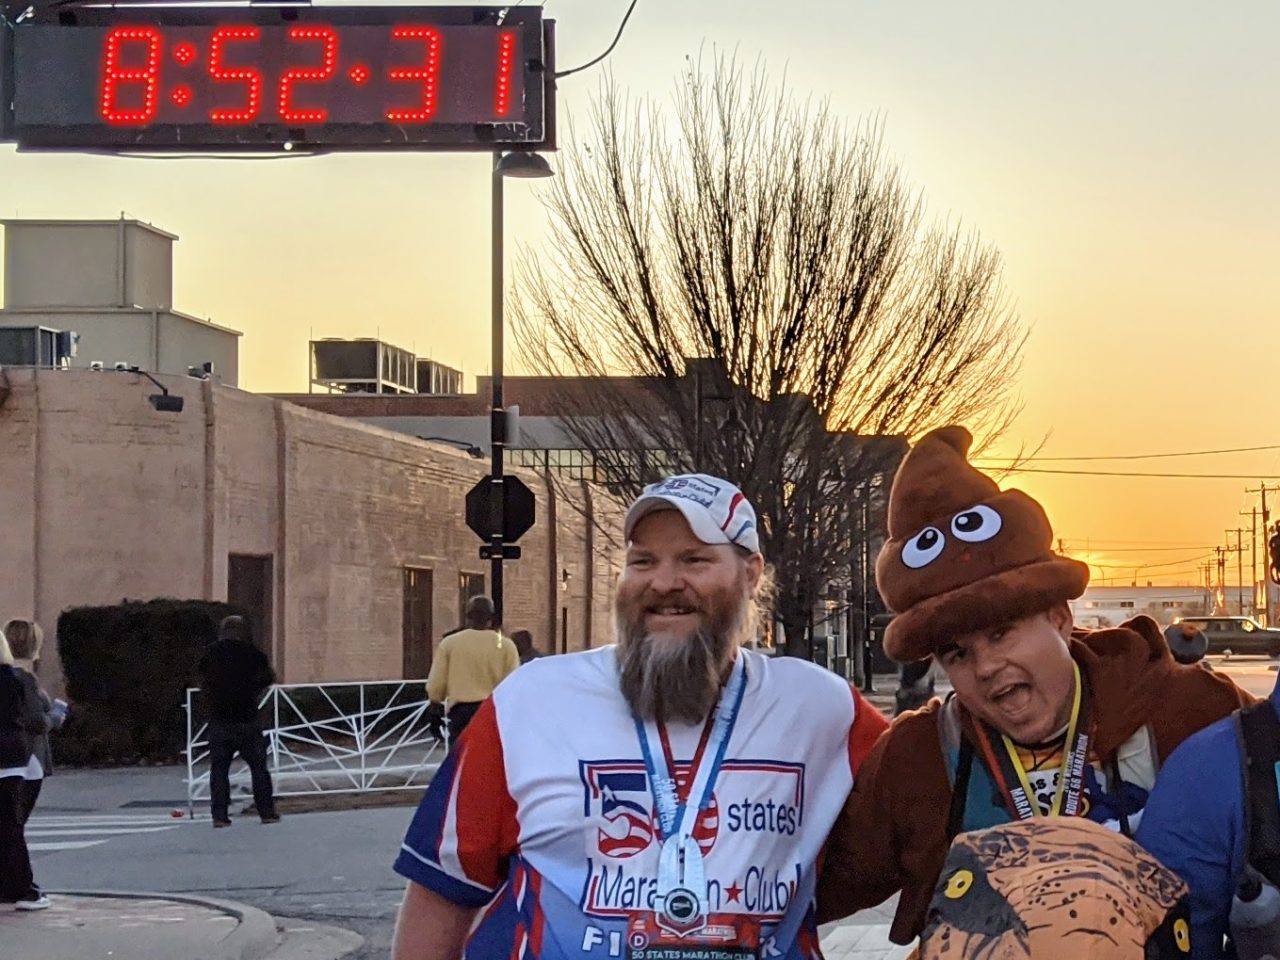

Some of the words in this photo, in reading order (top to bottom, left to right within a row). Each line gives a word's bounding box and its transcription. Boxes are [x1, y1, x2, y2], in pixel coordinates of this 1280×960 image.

[1072, 733, 1089, 778] MARATHON
[727, 796, 796, 836] states
[595, 864, 720, 911] Maran
[744, 866, 789, 912] Club
[632, 951, 645, 960] 50
[646, 950, 681, 959] STATES
[682, 950, 733, 960] MARATHON
